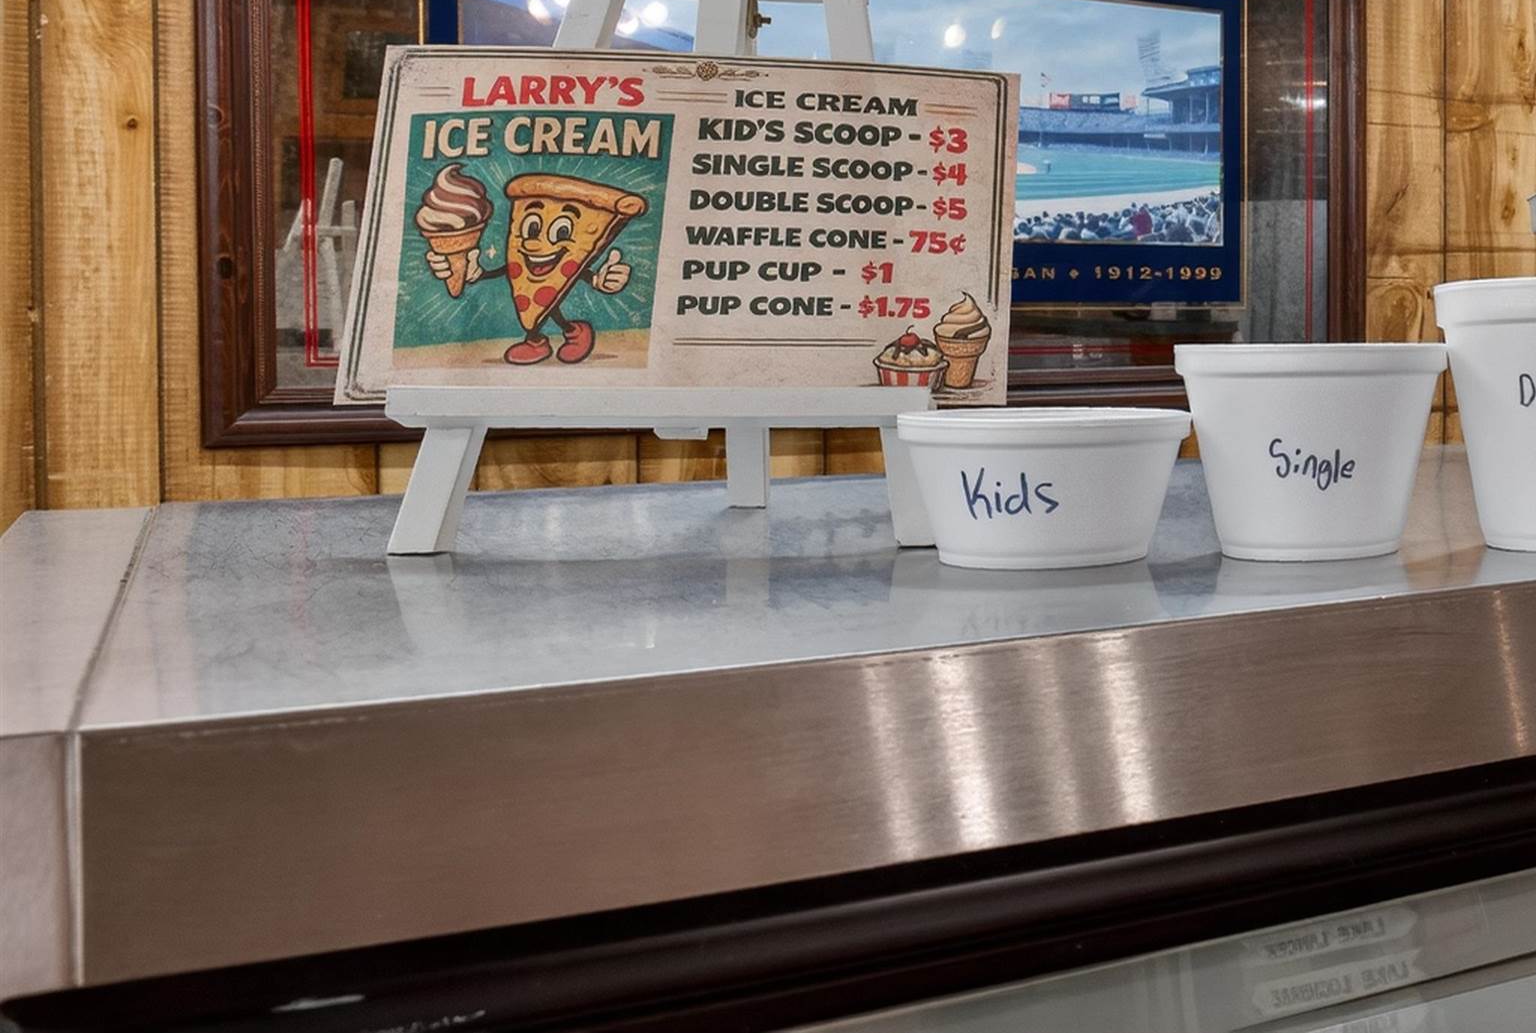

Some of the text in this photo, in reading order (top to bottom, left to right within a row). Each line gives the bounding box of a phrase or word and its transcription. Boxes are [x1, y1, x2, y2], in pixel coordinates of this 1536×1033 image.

[462, 75, 645, 107] LARRY'S
[735, 89, 919, 117] ICE CREAM
[422, 117, 662, 159] ICE CREAM
[697, 117, 786, 143] KID'S
[793, 122, 903, 147] SCOOP
[928, 128, 968, 154] $3
[691, 154, 805, 178] SINGLE
[812, 158, 914, 182] SCOOP
[932, 163, 968, 186] $4
[689, 189, 810, 214] DOUBLE
[816, 193, 914, 217] SCOOP
[932, 197, 968, 221] $5
[685, 225, 802, 248] WAFFLE
[808, 228, 888, 250] CONE
[909, 230, 967, 255] 75¢
[682, 259, 751, 282] PUP
[760, 261, 823, 284] CUP
[860, 263, 894, 284] $1
[1094, 265, 1223, 281] 1912-1999
[676, 294, 742, 316] PUP
[749, 296, 834, 318] CONE
[858, 296, 932, 321] $1.75
[1268, 438, 1356, 492] Single
[960, 467, 1060, 520] Kids
